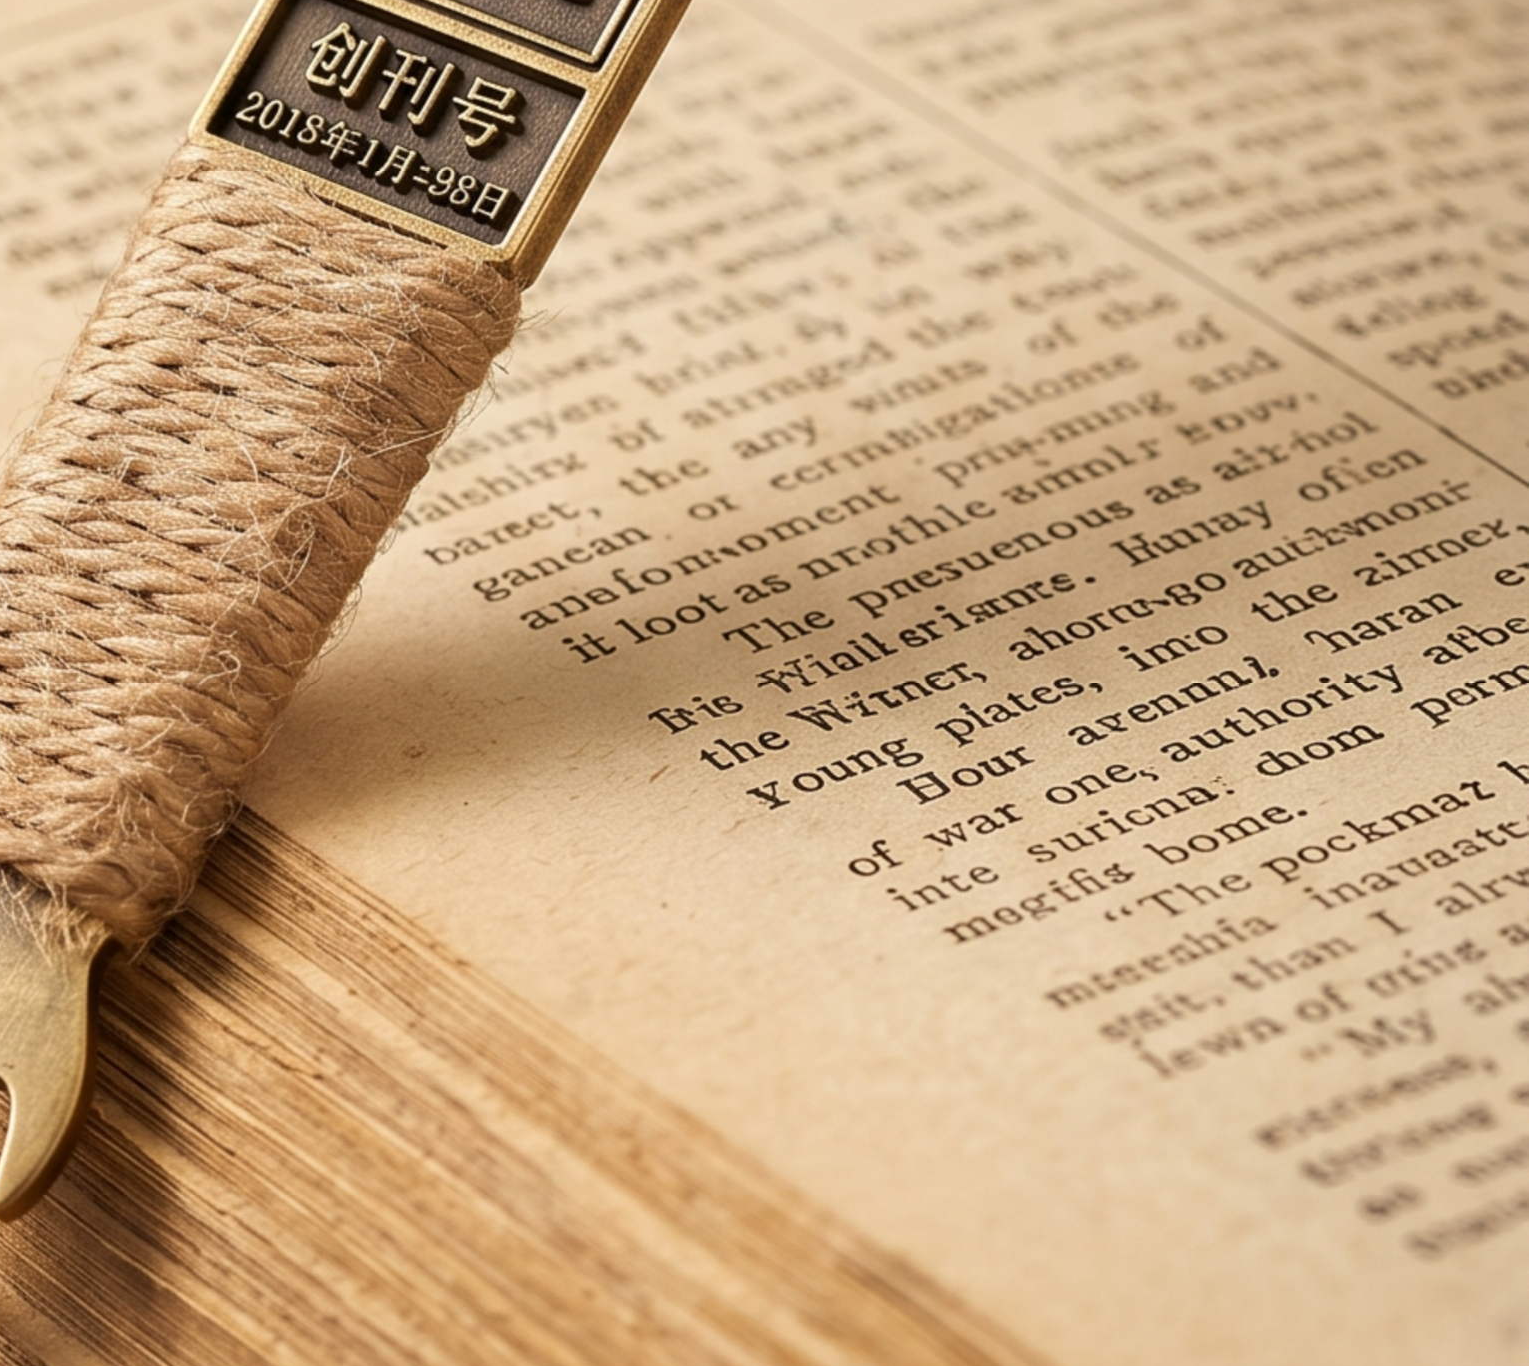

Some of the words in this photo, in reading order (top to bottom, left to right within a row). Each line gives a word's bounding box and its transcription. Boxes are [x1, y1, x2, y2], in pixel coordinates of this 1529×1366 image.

[305, 22, 519, 148] 创刊号
[1187, 346, 1283, 395] and
[618, 457, 710, 497] the
[732, 415, 817, 460] any
[687, 493, 741, 521] or
[723, 610, 835, 654] The
[1144, 475, 1201, 506] as
[562, 633, 616, 664] it
[615, 593, 729, 644] loot
[733, 574, 792, 604] as
[1252, 583, 1338, 622] the
[699, 730, 790, 771] the
[848, 840, 902, 877] of
[923, 802, 1023, 848] war
[1160, 664, 1403, 762] authority
[1143, 805, 1307, 865] bome.
[886, 865, 999, 912] inte
[1231, 938, 1358, 991] than
[1368, 909, 1410, 935] I
[1295, 984, 1352, 1023] of
